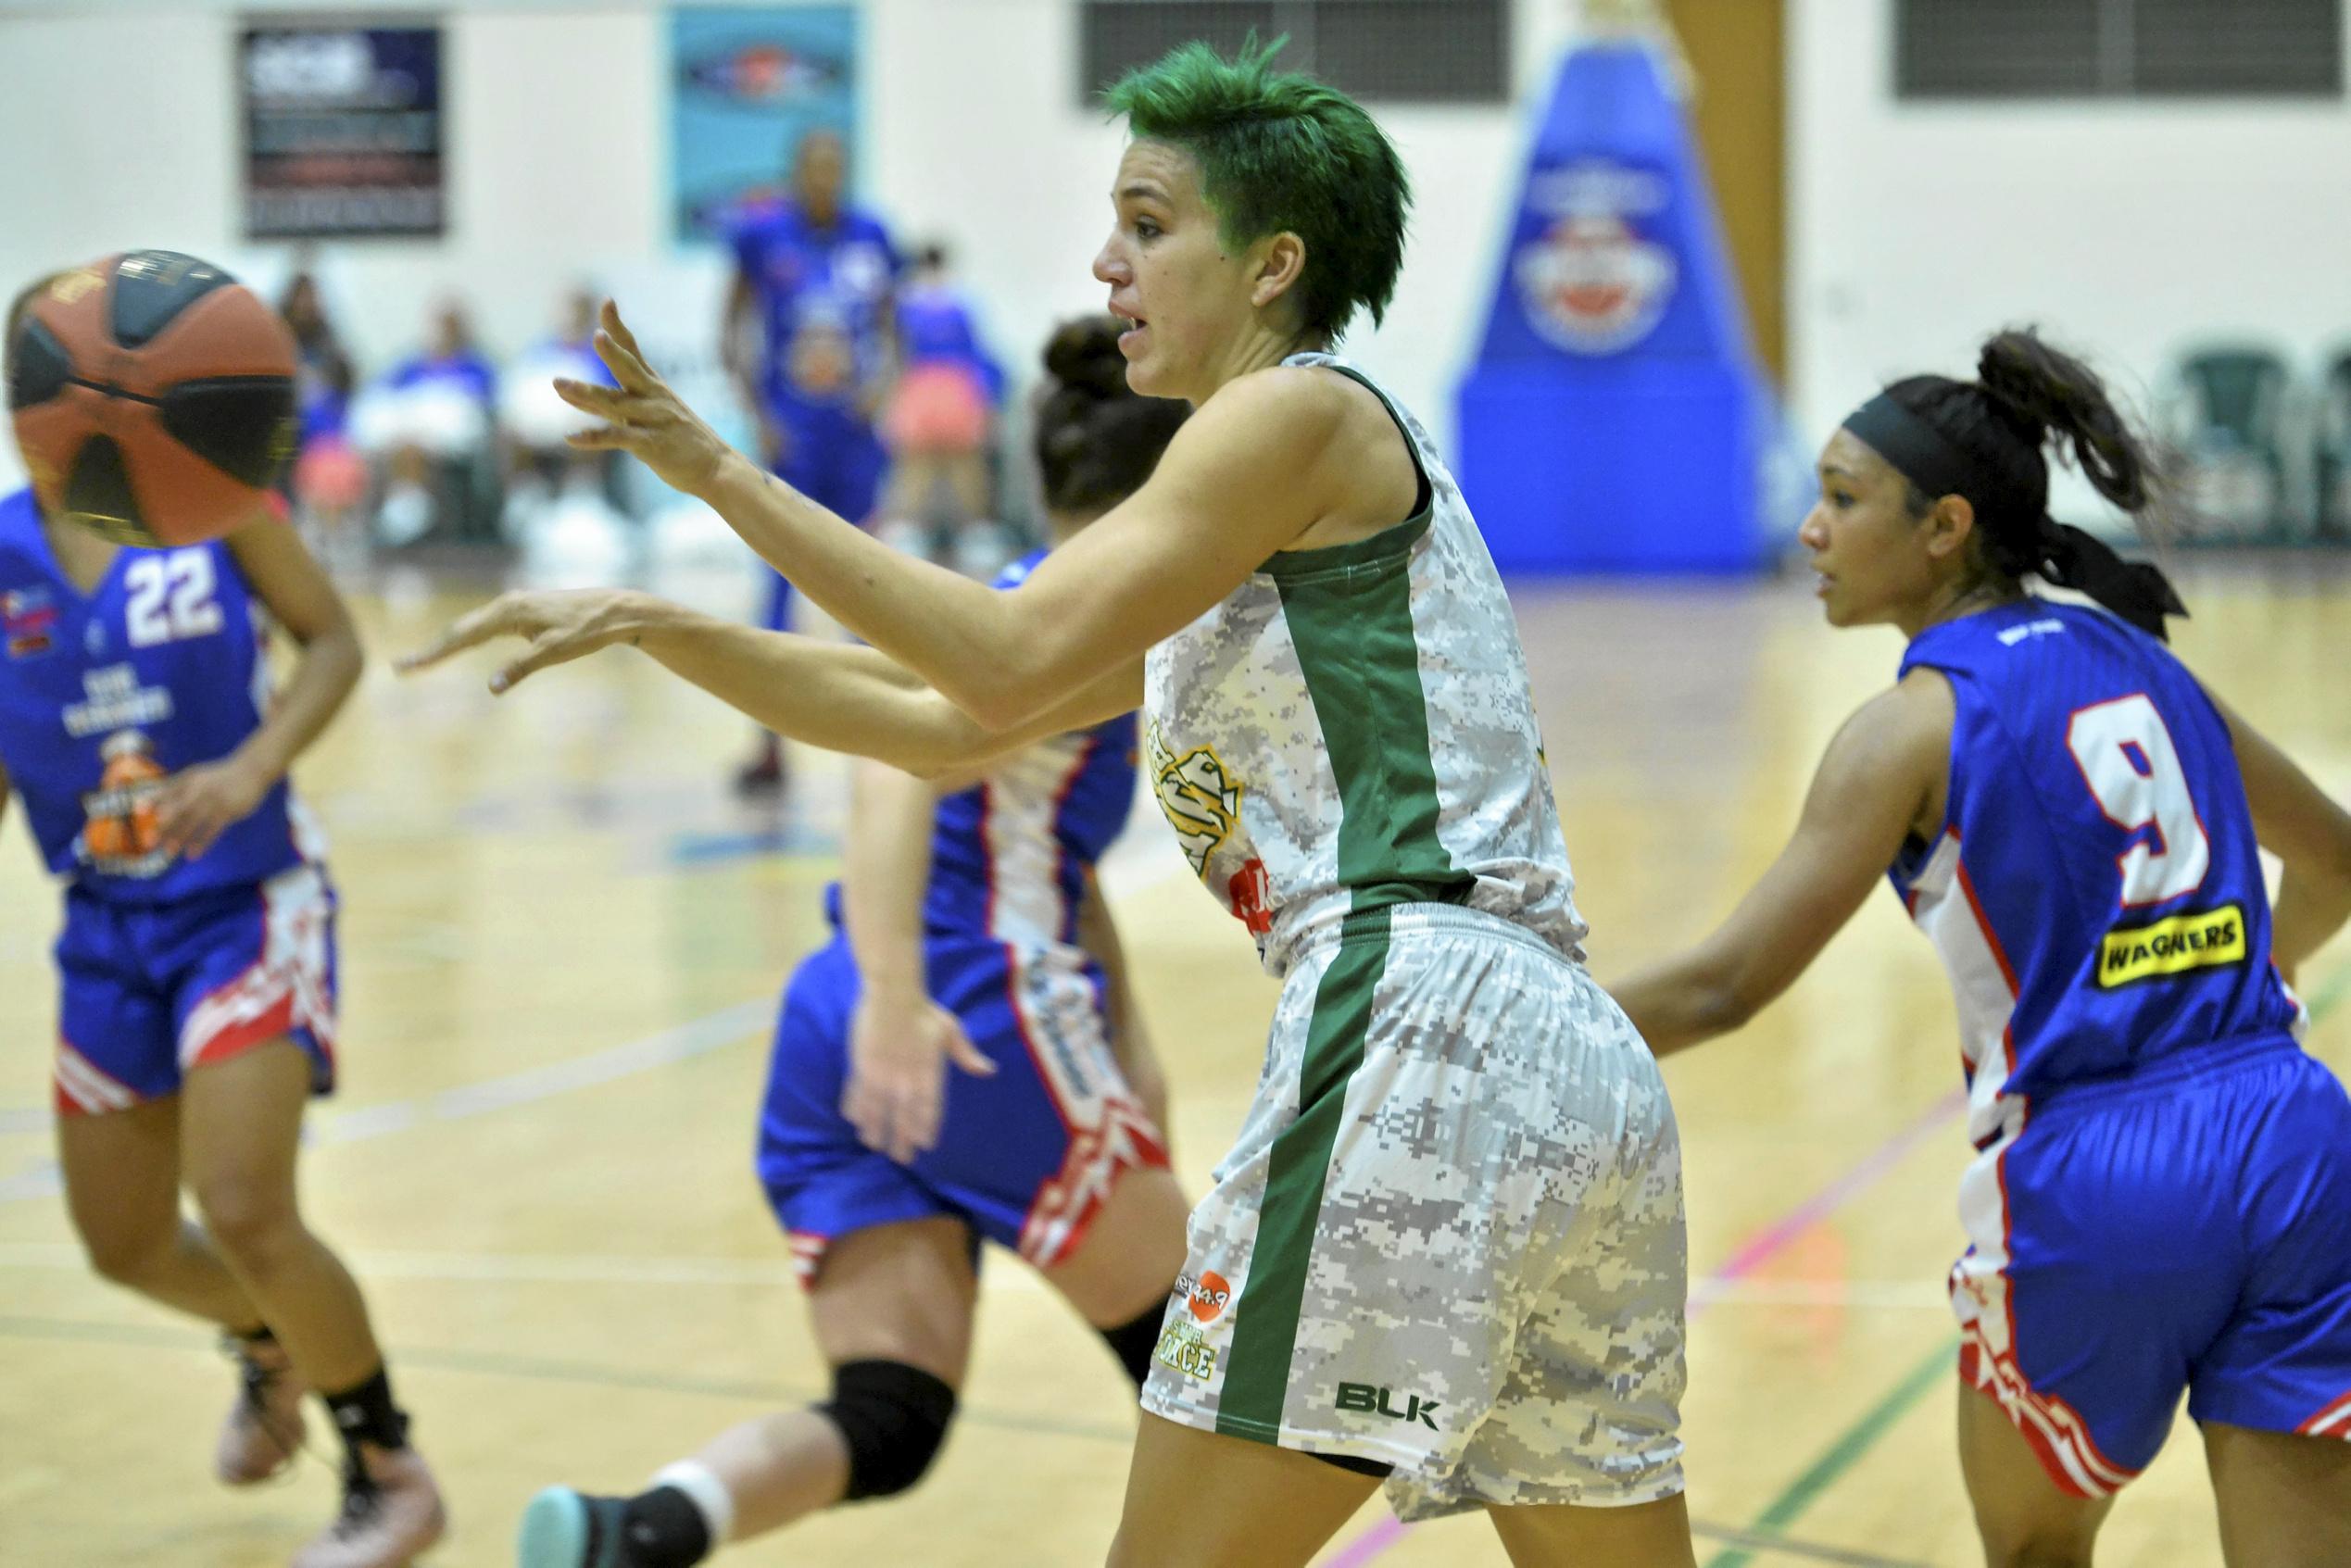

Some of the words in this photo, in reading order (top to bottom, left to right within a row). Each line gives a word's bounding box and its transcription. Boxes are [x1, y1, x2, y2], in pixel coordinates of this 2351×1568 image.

[123, 545, 225, 649] 22
[2066, 694, 2210, 909] 9
[2106, 920, 2238, 971] WAGNERS
[1335, 1381, 1440, 1432] BLK
